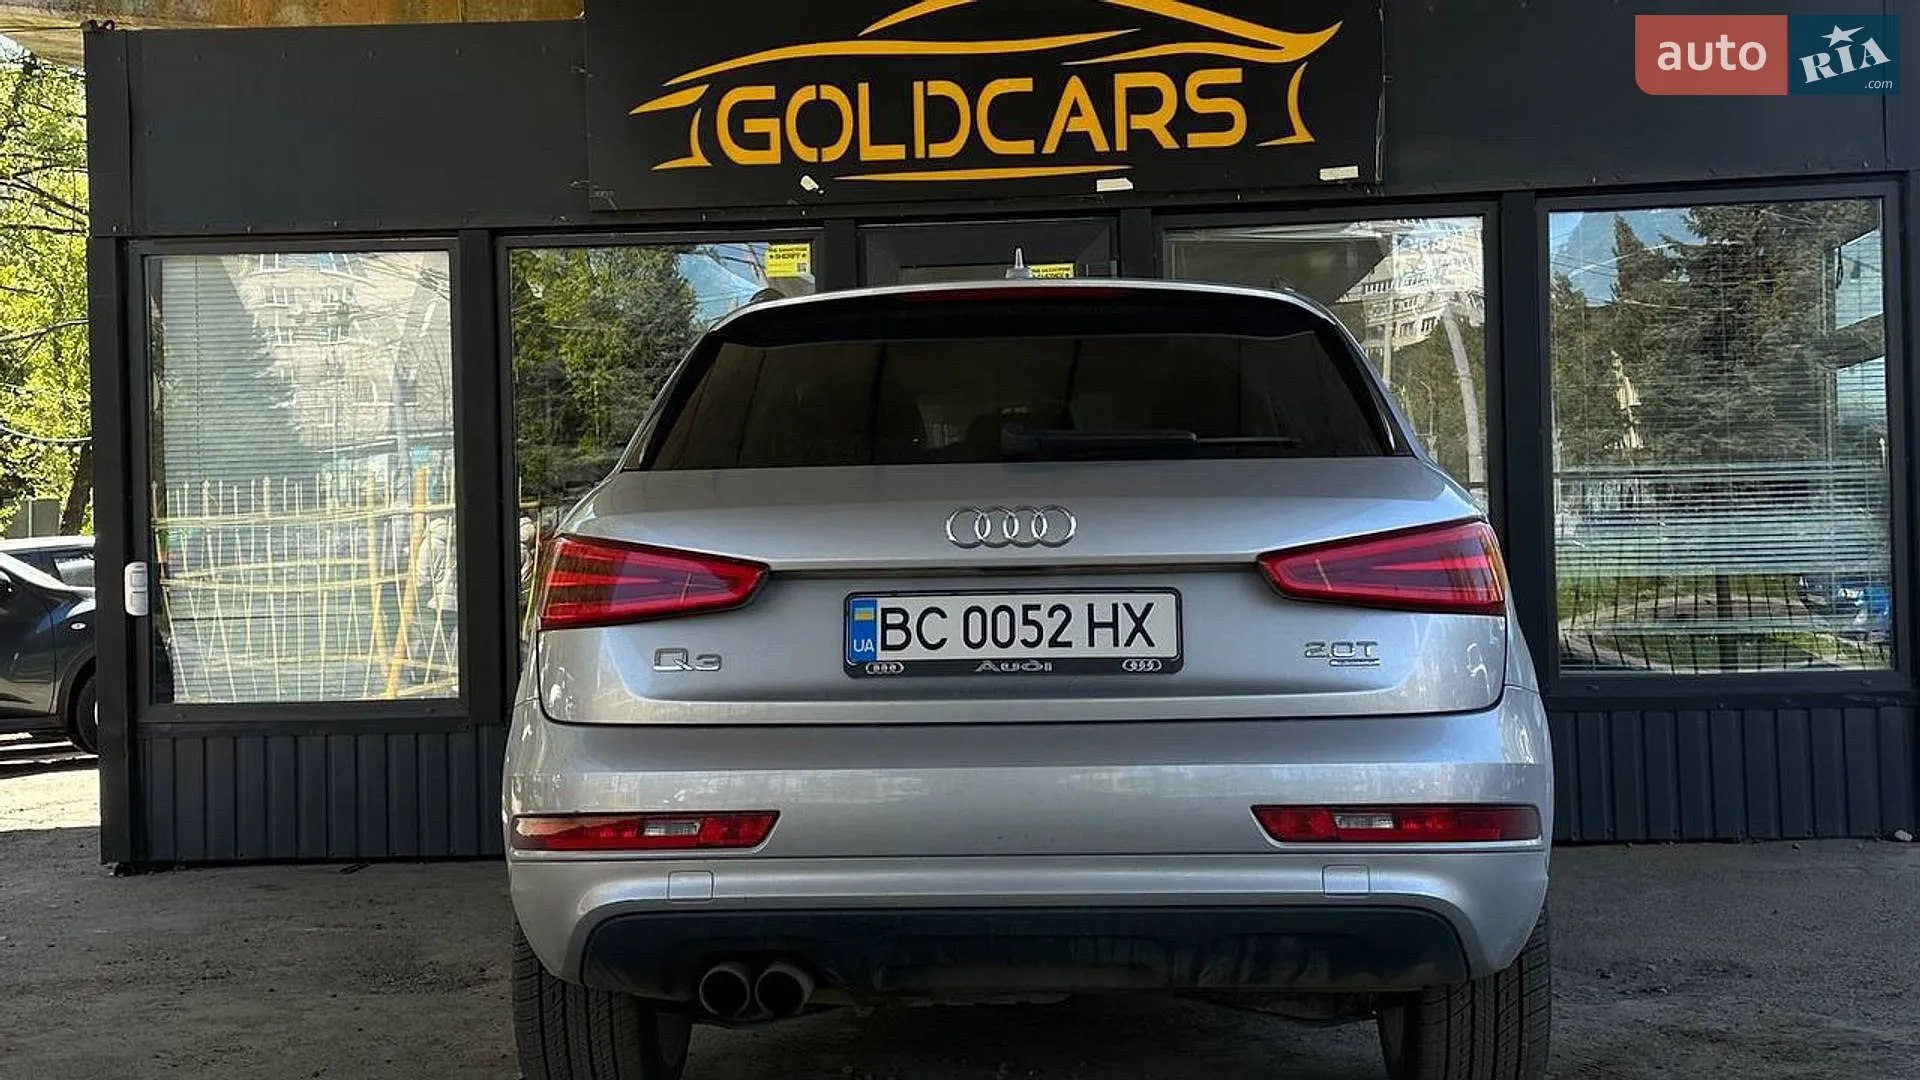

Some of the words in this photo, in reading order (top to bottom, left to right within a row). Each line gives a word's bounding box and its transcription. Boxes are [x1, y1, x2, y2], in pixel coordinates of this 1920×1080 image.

[715, 67, 1248, 165] GOLDCARS
[880, 606, 948, 651] BC
[963, 603, 1073, 650] 0052
[1087, 602, 1155, 648] HX
[653, 648, 722, 672] Q3
[853, 639, 875, 653] UA
